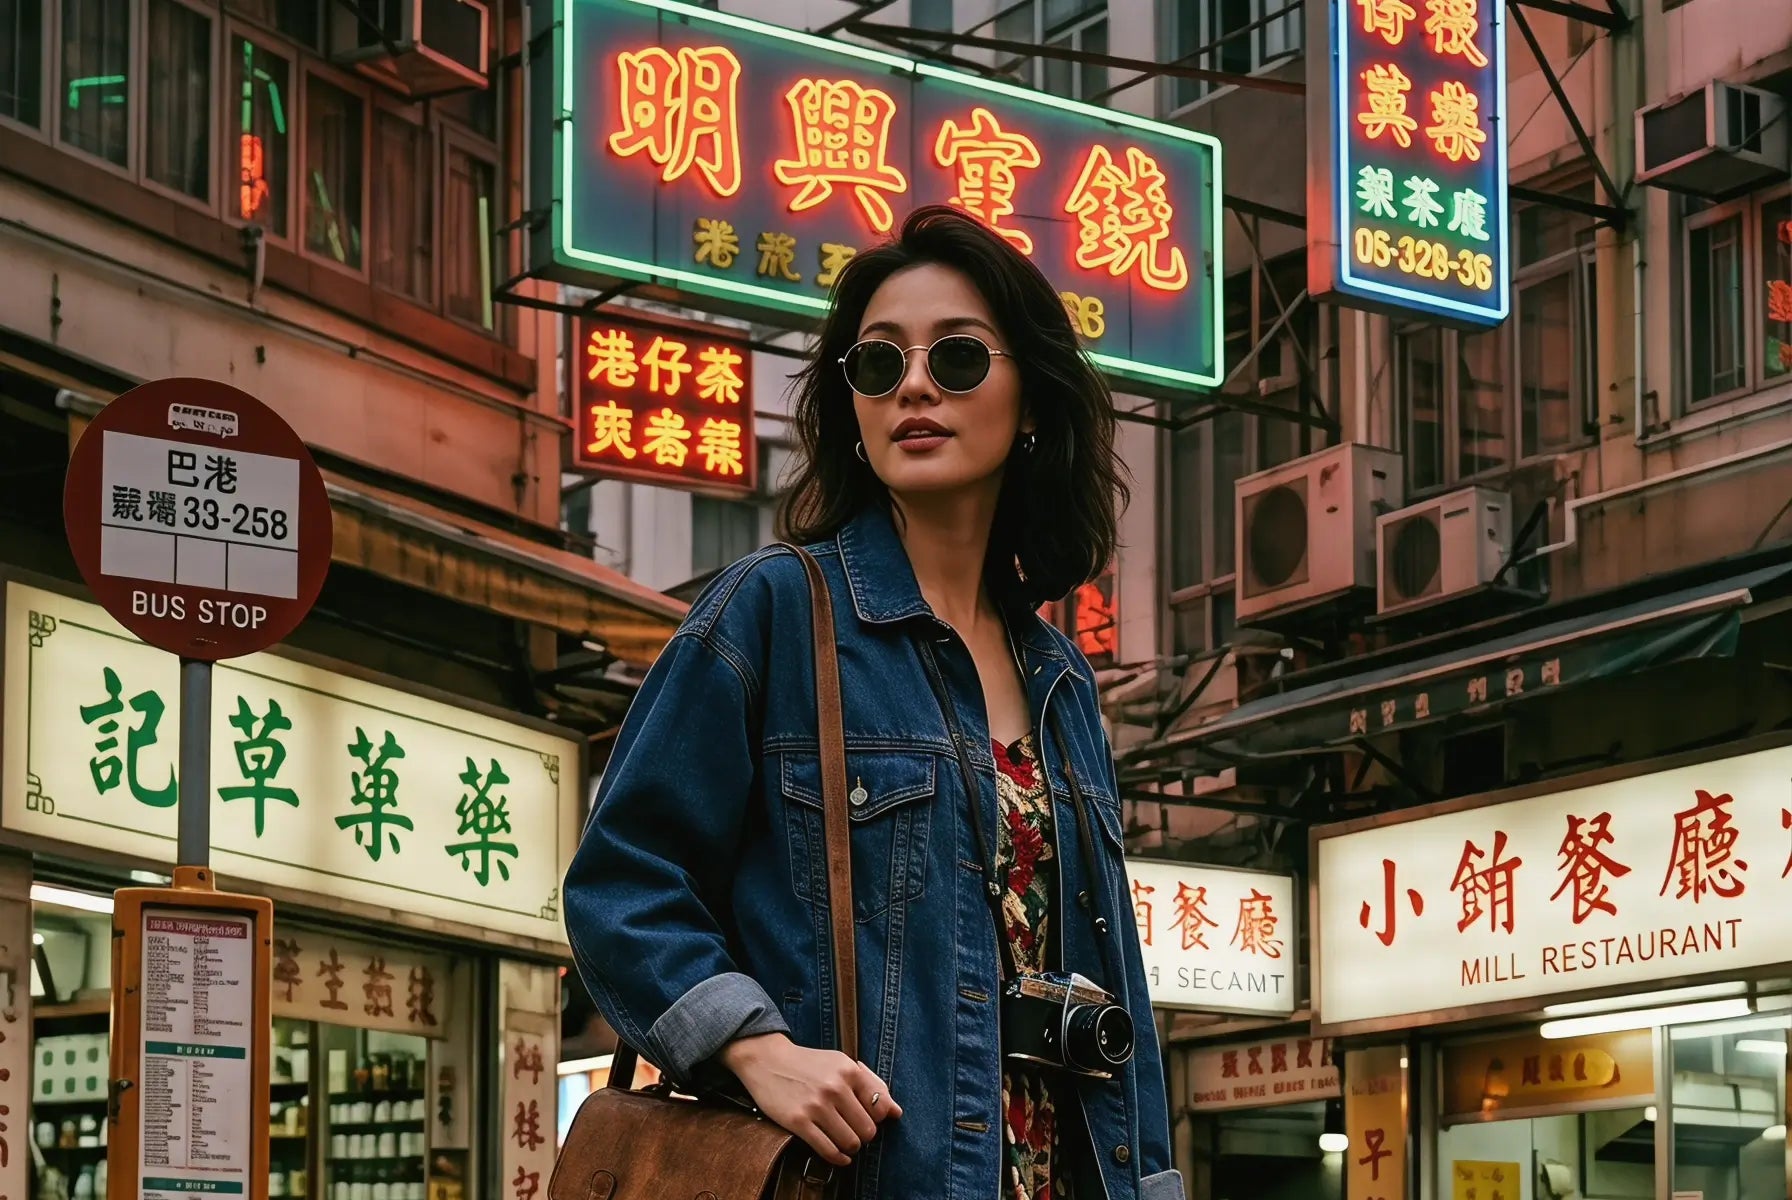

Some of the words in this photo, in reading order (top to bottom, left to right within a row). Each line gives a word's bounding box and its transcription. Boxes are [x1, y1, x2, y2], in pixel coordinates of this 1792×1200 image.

[183, 496, 288, 540] 33-258
[132, 590, 186, 620] BUS
[198, 599, 267, 629] STOP
[1461, 953, 1526, 986] MILL
[1542, 918, 1743, 975] RESTAURANT
